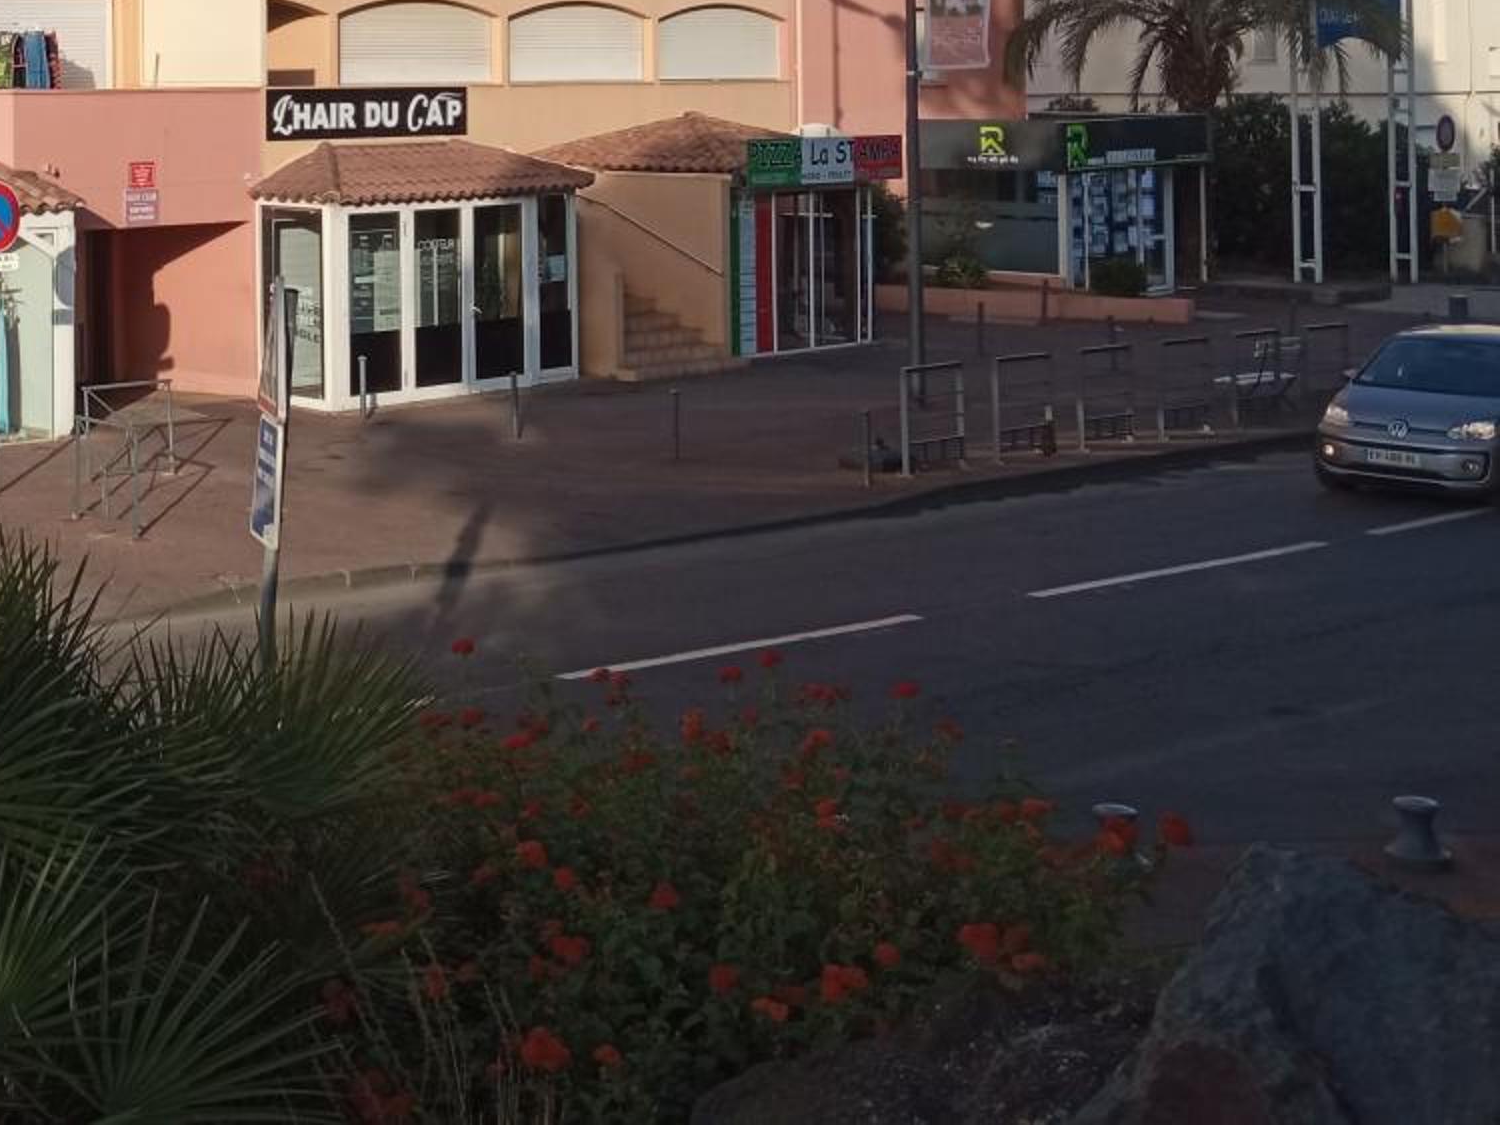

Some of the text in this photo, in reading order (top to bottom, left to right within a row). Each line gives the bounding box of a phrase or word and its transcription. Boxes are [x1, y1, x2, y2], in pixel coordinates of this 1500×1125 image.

[364, 100, 399, 128] DU
[407, 92, 464, 132] CAP
[811, 142, 829, 166] La
